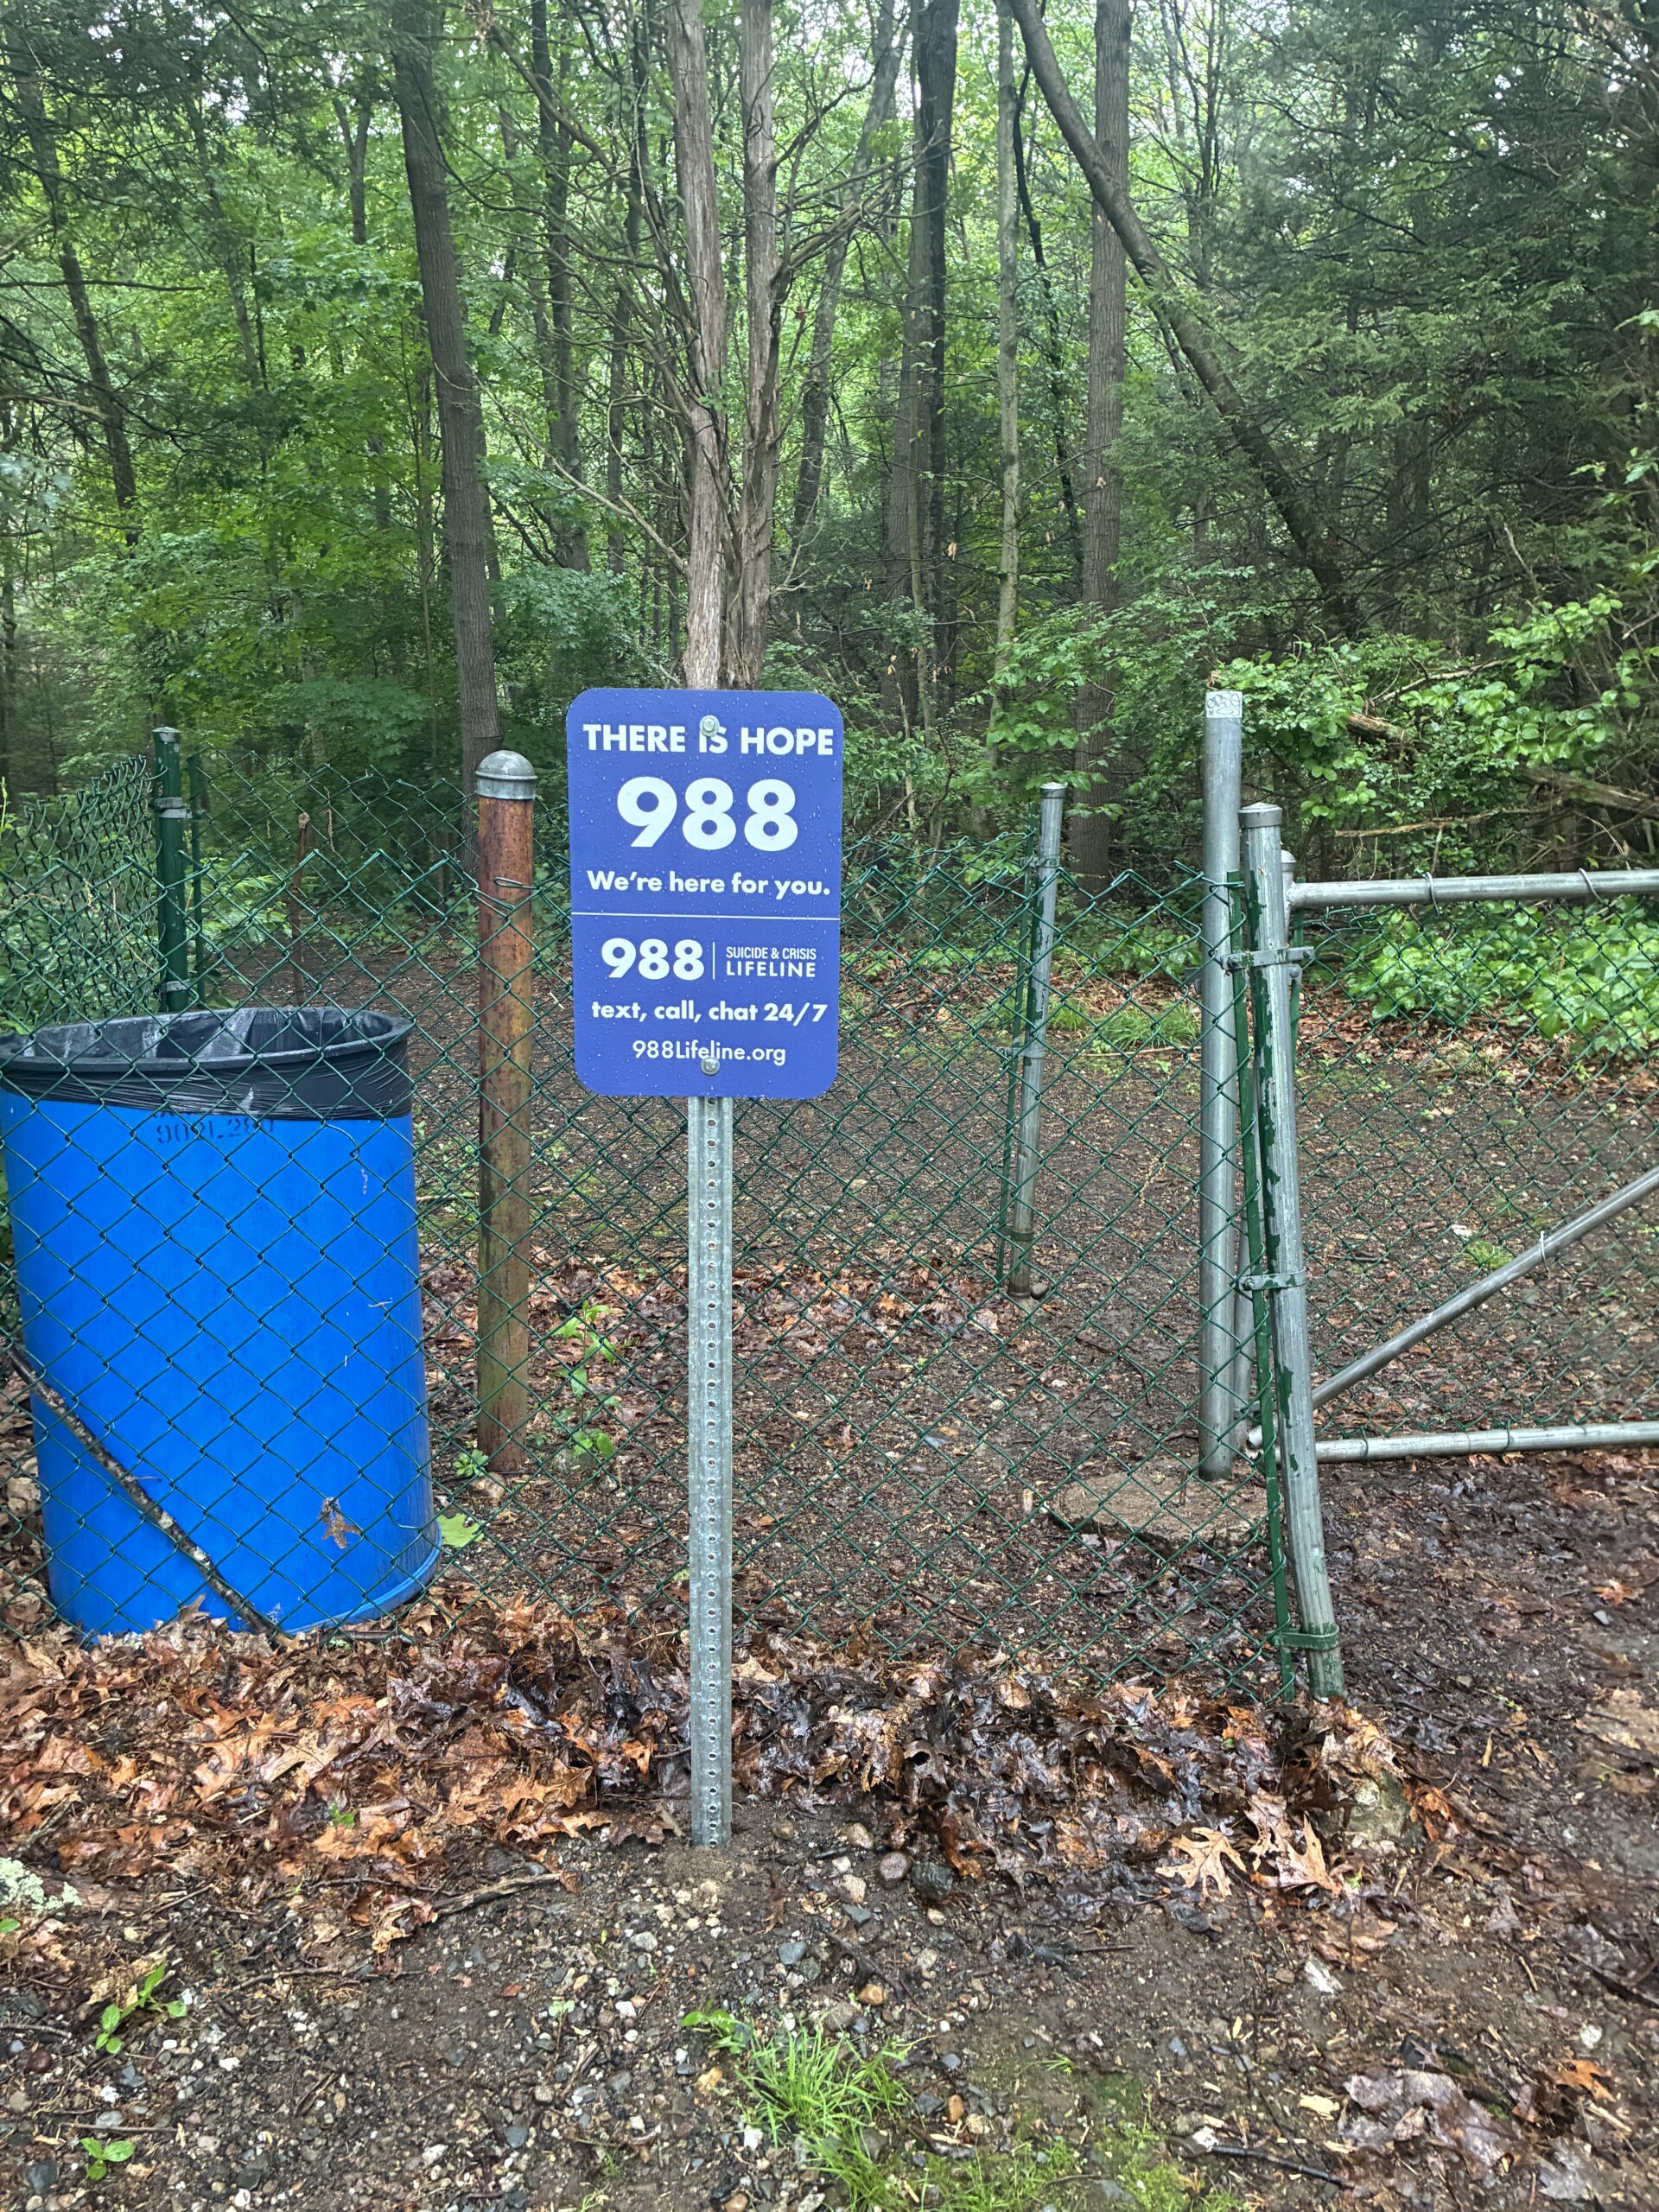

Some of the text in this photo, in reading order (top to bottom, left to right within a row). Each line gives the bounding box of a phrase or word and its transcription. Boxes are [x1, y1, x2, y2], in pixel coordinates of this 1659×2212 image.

[582, 724, 834, 756] THERE IS HOPE
[617, 776, 798, 851] 988
[587, 870, 830, 900] We're here for you.
[601, 938, 705, 981] 988
[726, 946, 817, 960] SUICIDE & CRISIS
[726, 961, 817, 977] LIFELINE
[591, 1000, 828, 1027] text, call, chat 24/7
[632, 1039, 786, 1066] 988Lifeline.org
